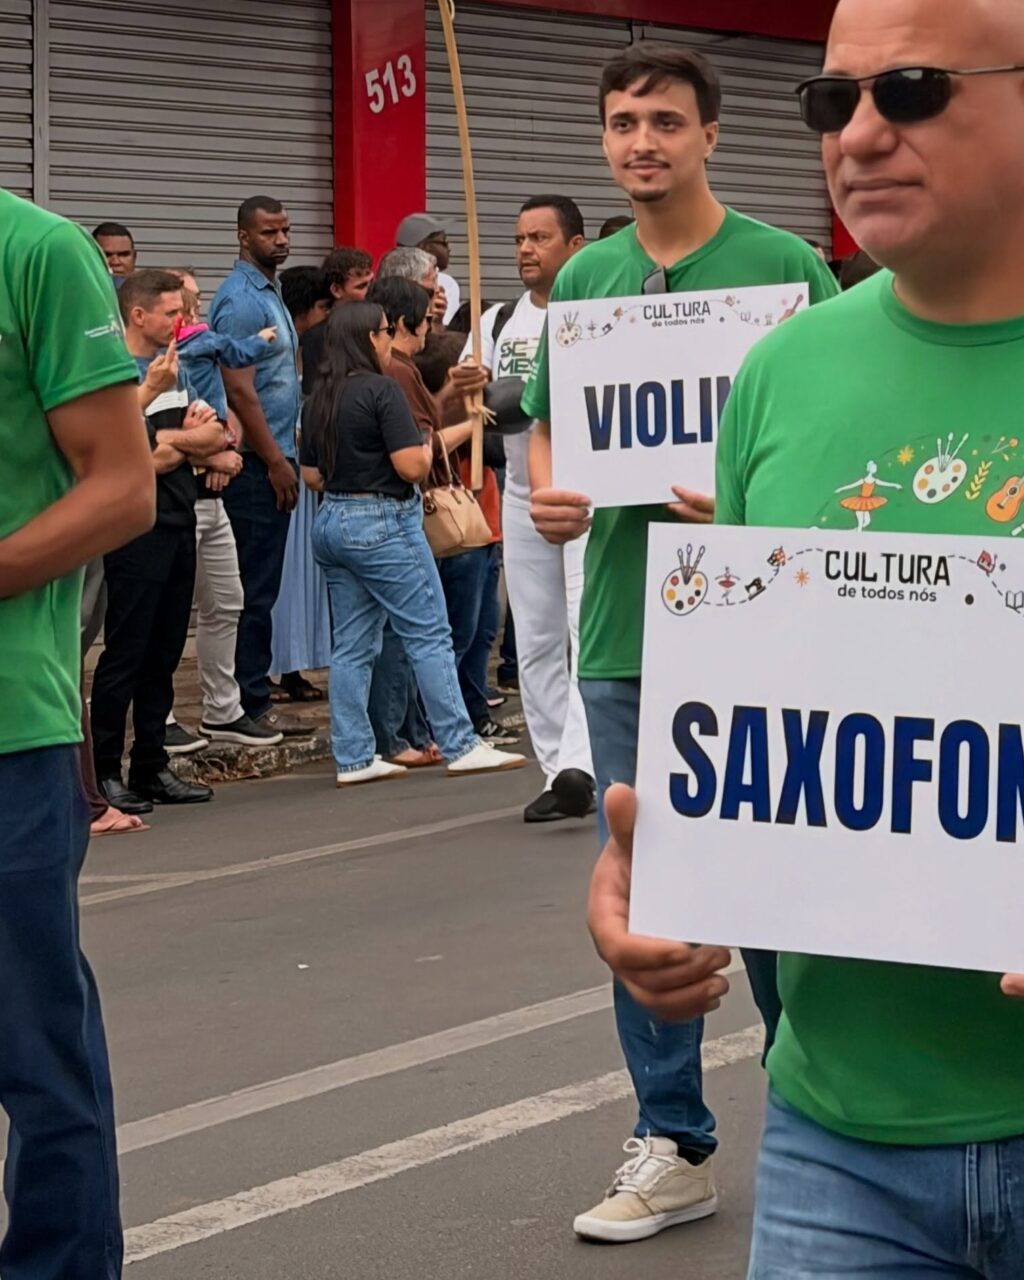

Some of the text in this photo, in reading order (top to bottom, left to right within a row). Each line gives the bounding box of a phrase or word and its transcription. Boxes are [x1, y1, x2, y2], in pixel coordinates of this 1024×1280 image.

[365, 54, 417, 114] 513
[643, 300, 711, 320] CULTURA
[651, 320, 663, 328] de
[664, 319, 688, 327] todos
[825, 550, 950, 586] CULTURA
[837, 583, 937, 602] de todos nós
